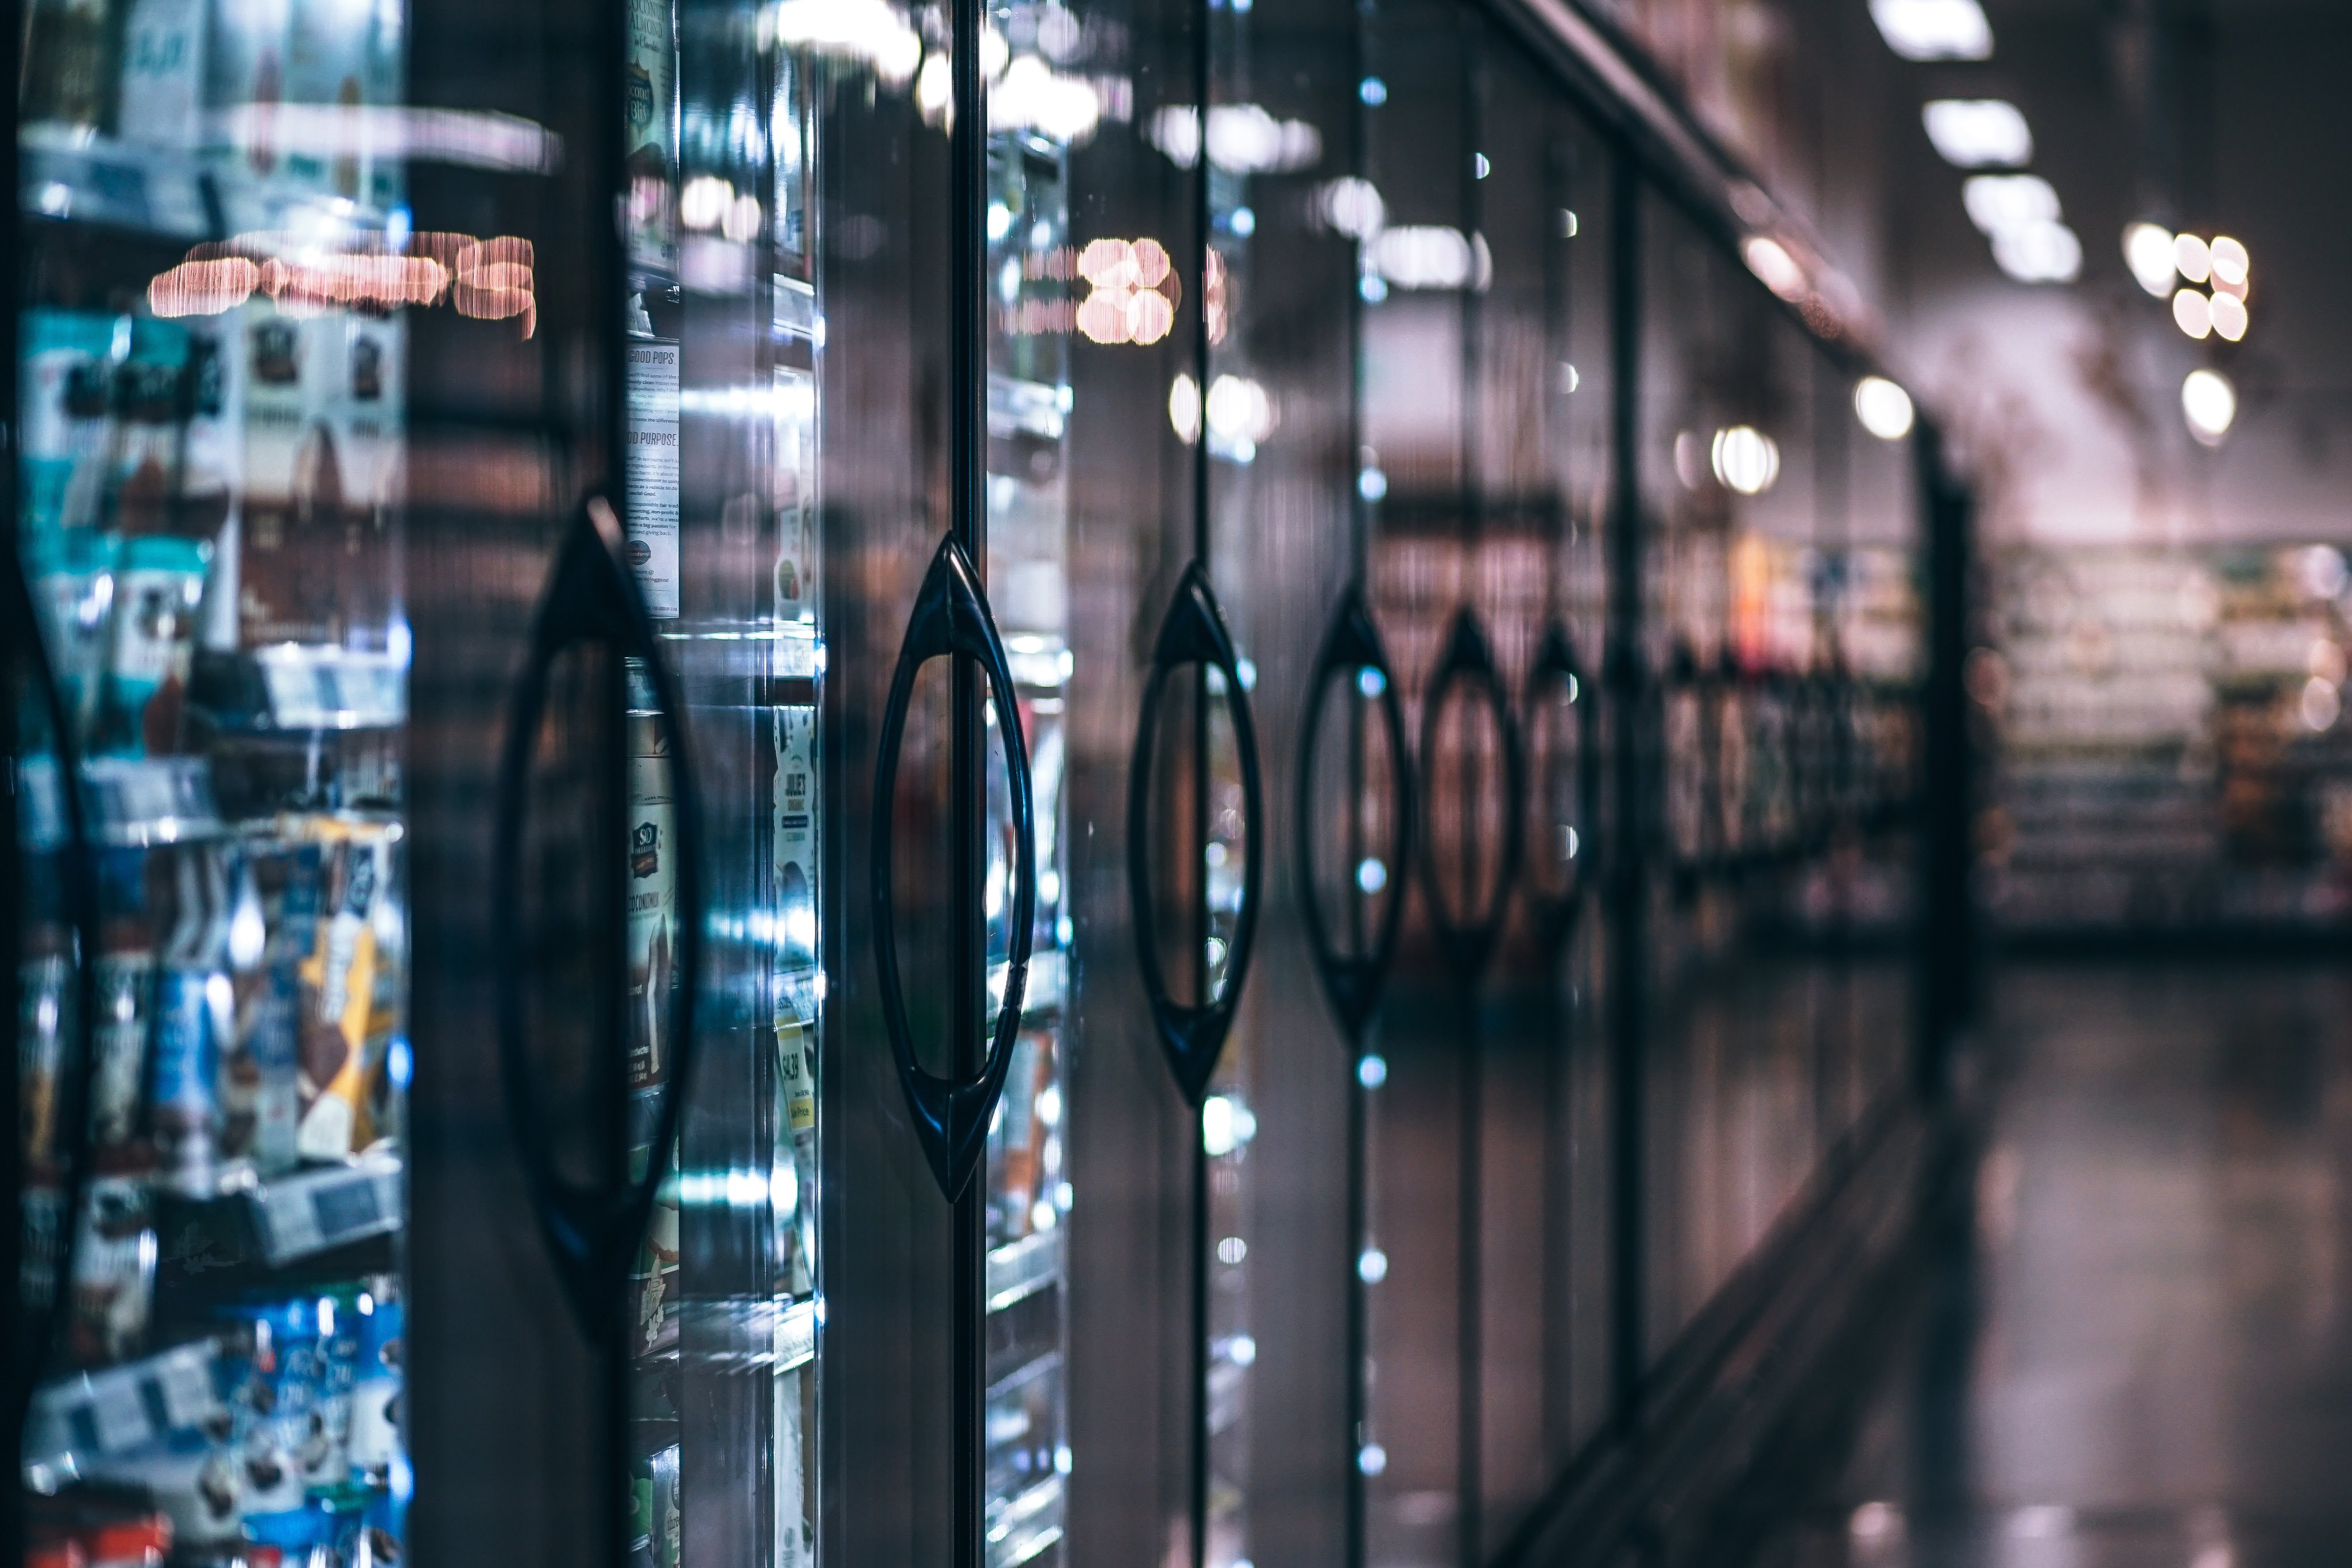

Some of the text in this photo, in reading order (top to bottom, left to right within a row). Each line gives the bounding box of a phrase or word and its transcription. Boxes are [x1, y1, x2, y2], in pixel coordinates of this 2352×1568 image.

[630, 11, 663, 38] ALMOND
[629, 350, 676, 365] GOOD POPS.
[640, 432, 679, 446] PURPOSE.
[639, 827, 652, 845] SO
